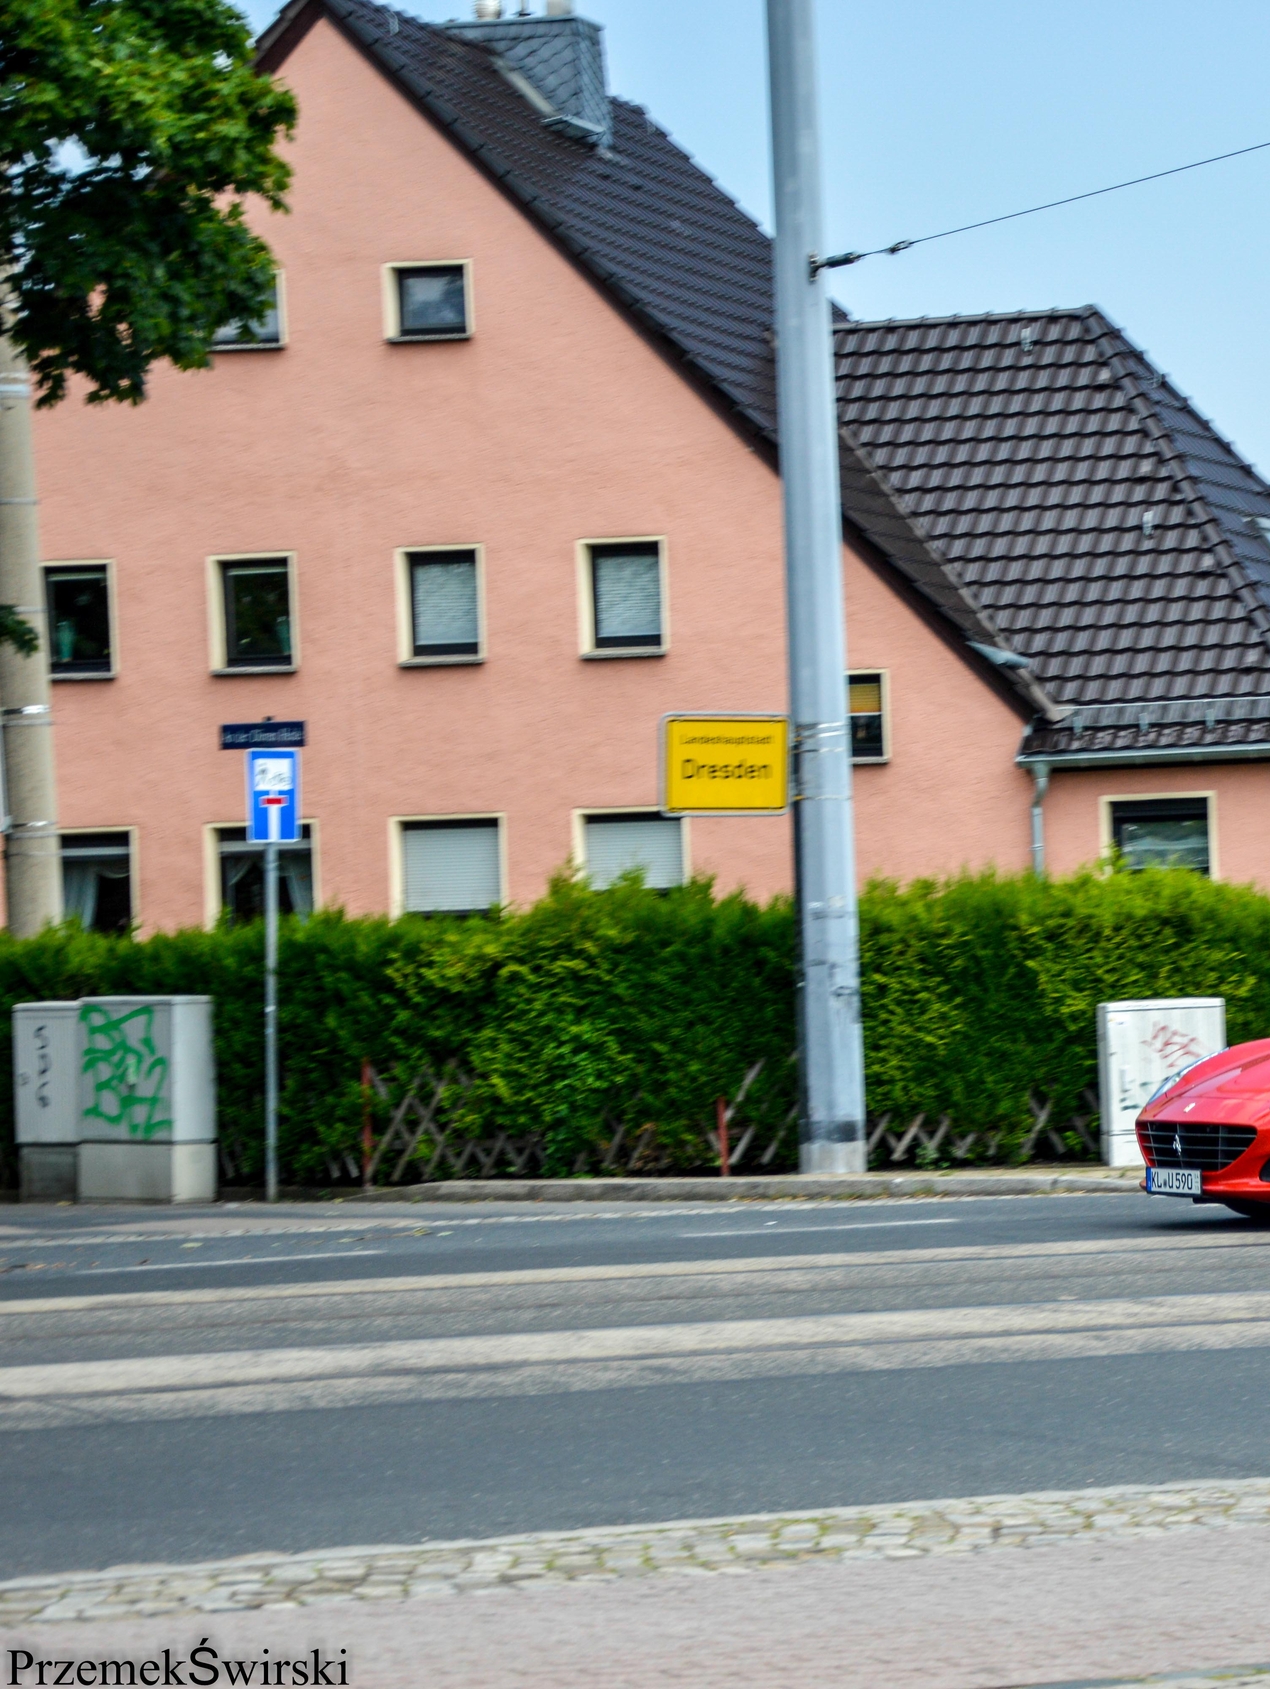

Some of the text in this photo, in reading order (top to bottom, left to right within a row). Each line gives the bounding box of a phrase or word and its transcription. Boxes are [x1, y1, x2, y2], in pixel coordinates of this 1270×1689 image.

[681, 758, 773, 780] Dresden
[1151, 1171, 1162, 1188] KL
[1175, 1172, 1193, 1190] 590
